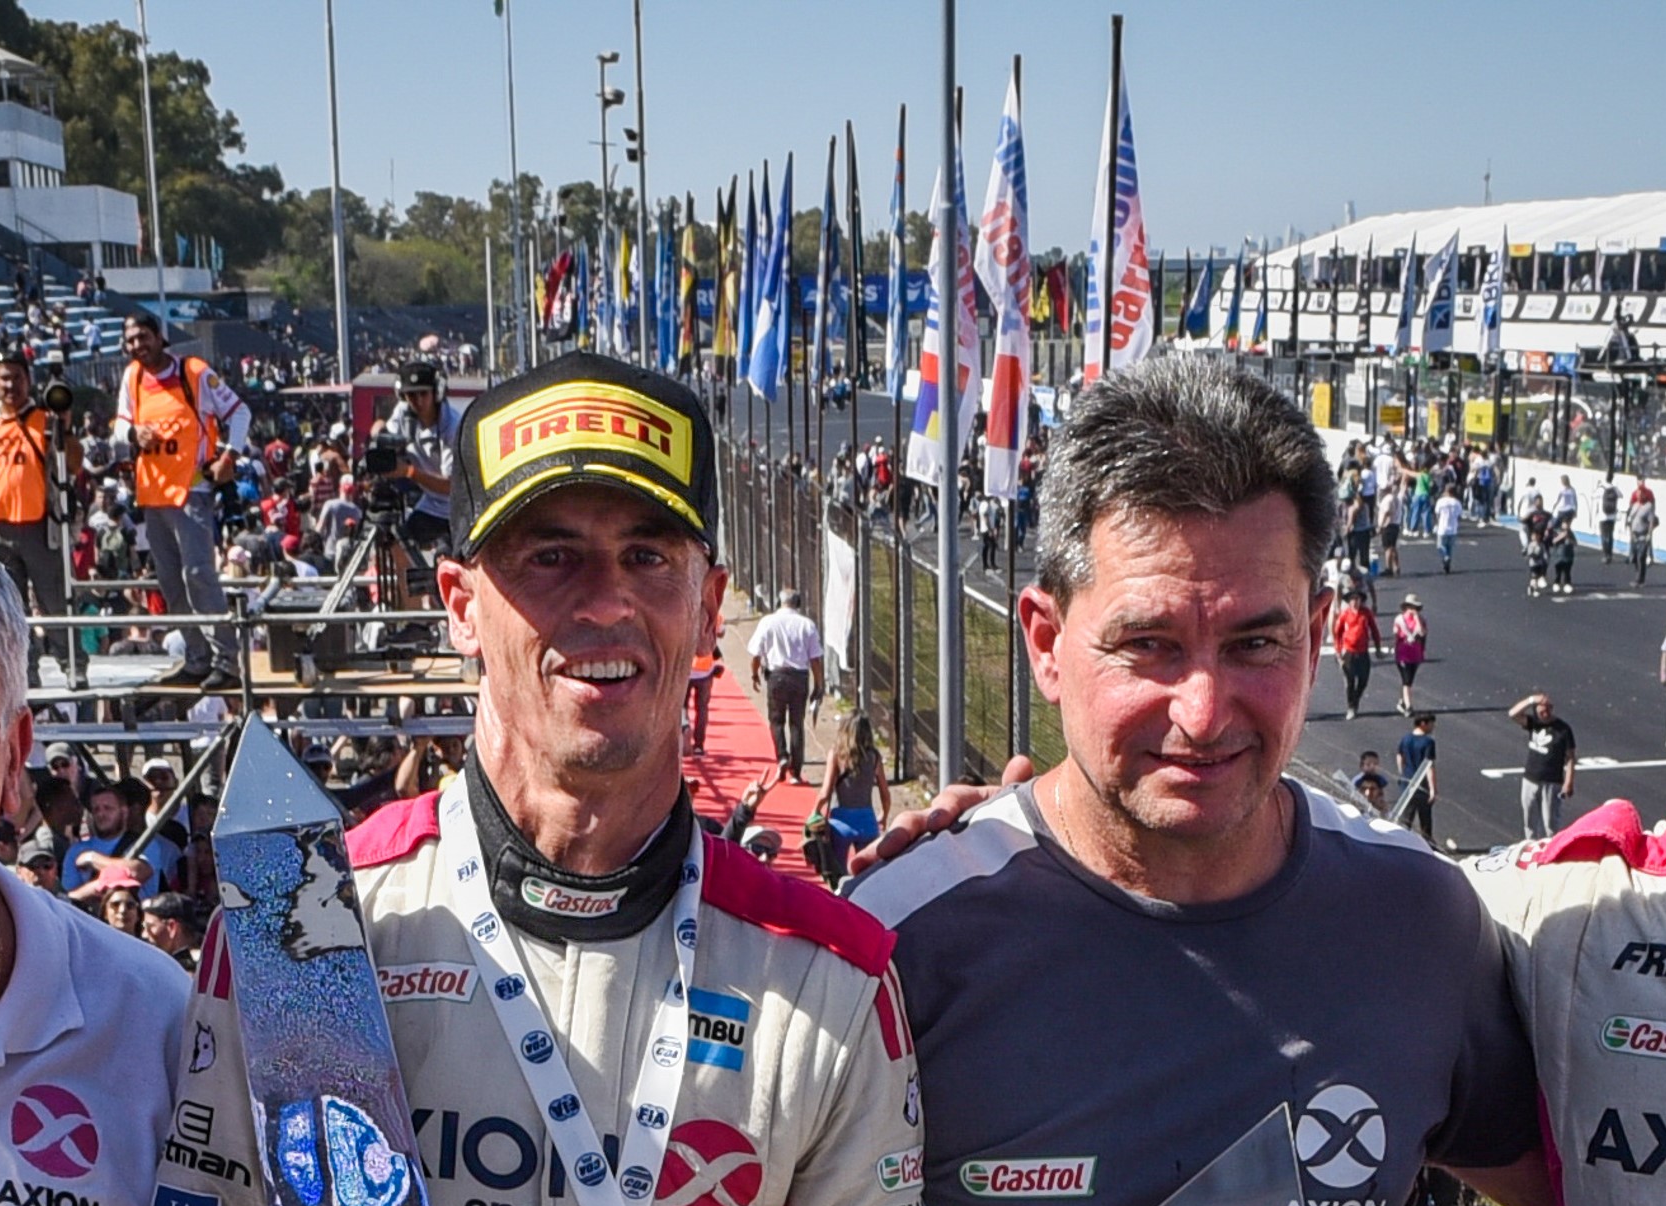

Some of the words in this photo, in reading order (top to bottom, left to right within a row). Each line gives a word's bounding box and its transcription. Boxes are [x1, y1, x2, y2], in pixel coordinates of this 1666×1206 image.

[499, 397, 672, 461] PIRELLI
[456, 860, 479, 883] FIA
[545, 888, 618, 914] Castrol
[498, 975, 524, 996] FIA
[689, 1013, 744, 1045] MBU
[639, 1104, 665, 1124] FIA
[990, 1162, 1084, 1193] Castrol
